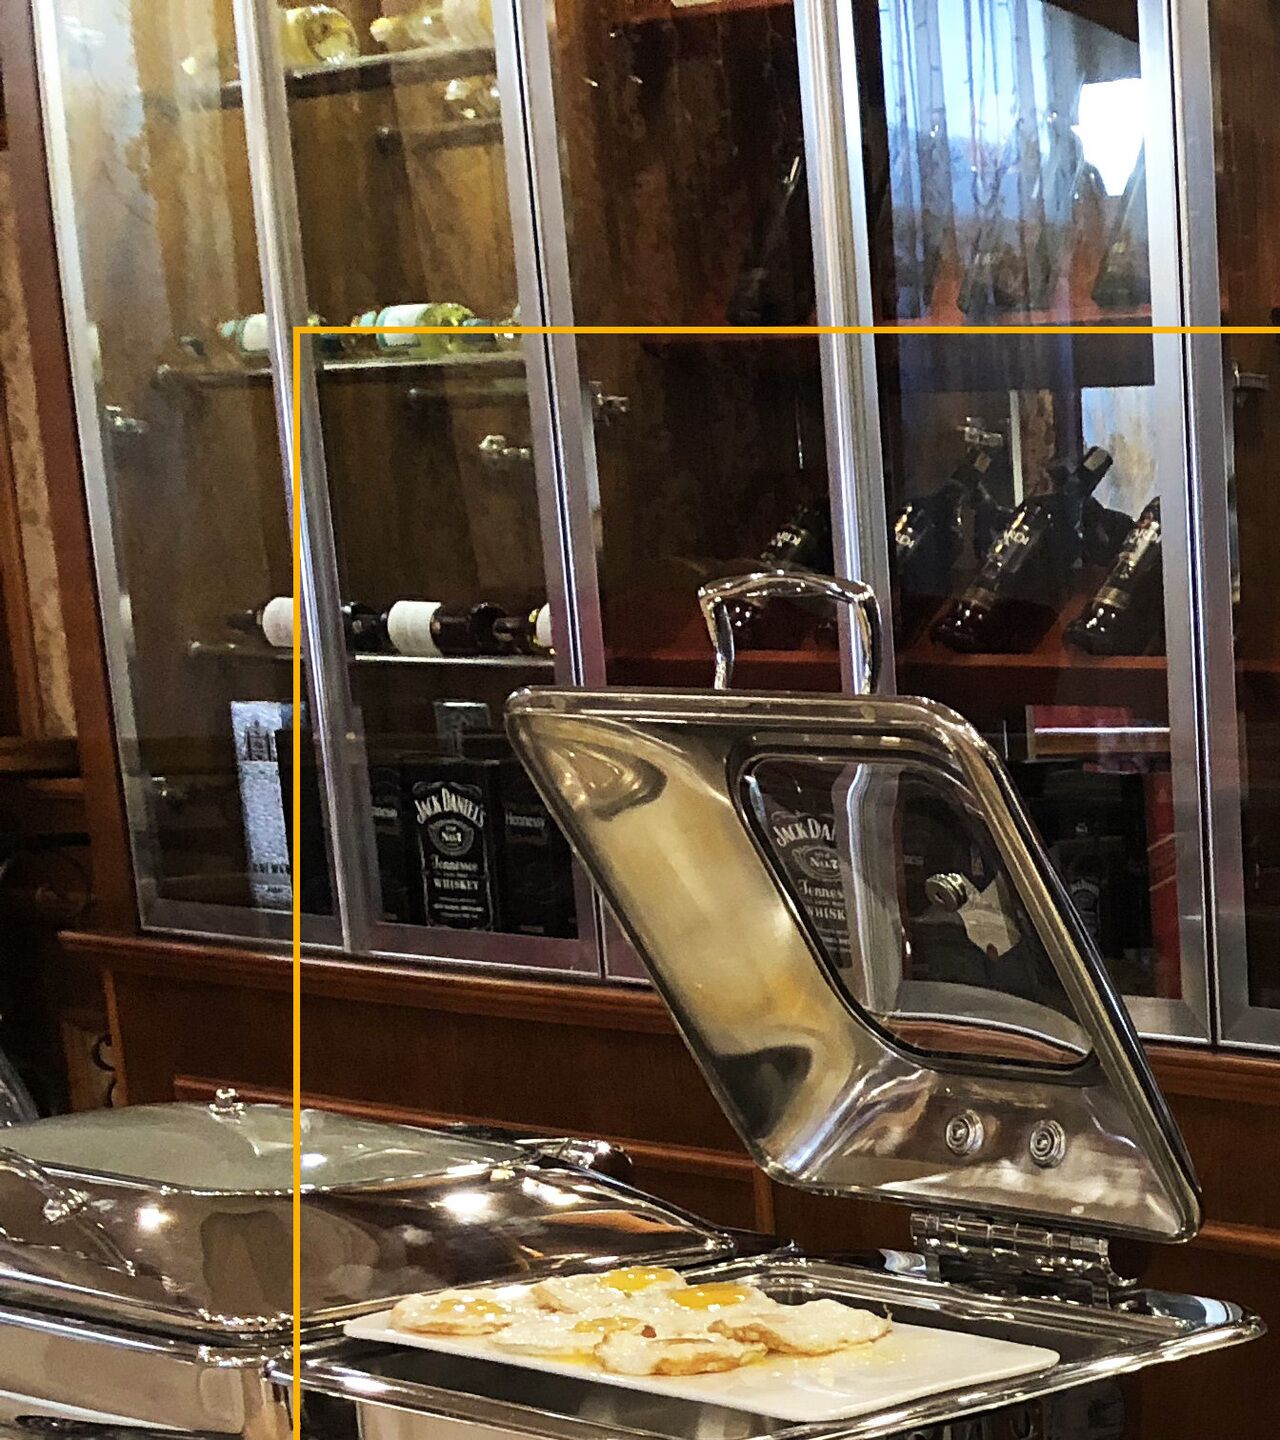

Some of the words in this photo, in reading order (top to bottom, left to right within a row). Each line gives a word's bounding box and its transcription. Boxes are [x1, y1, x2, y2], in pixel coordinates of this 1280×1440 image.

[414, 796, 442, 825] JACK
[441, 786, 487, 829] DANIEL'S
[773, 822, 809, 848] JACK
[807, 907, 846, 921] WHISK
